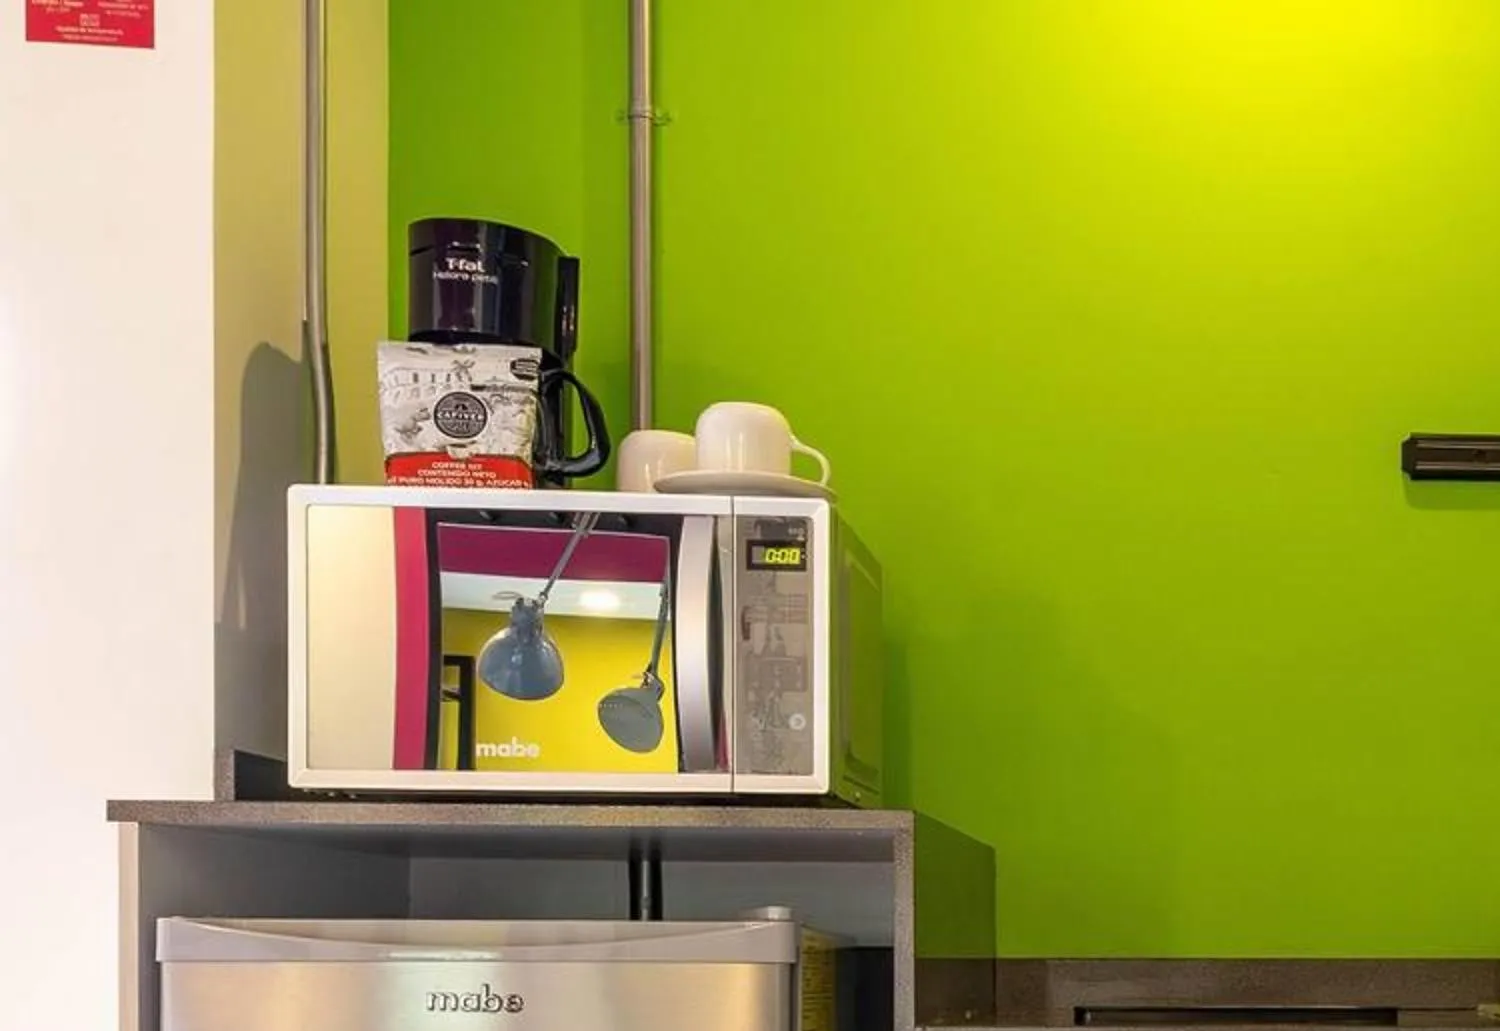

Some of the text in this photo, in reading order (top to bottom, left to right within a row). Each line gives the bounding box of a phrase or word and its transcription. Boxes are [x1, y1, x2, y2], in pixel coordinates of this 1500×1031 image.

[431, 461, 466, 469] COFFEE
[417, 469, 497, 479] CONTENIDO NETO
[476, 735, 541, 759] mabe
[426, 983, 524, 1013] mabe
